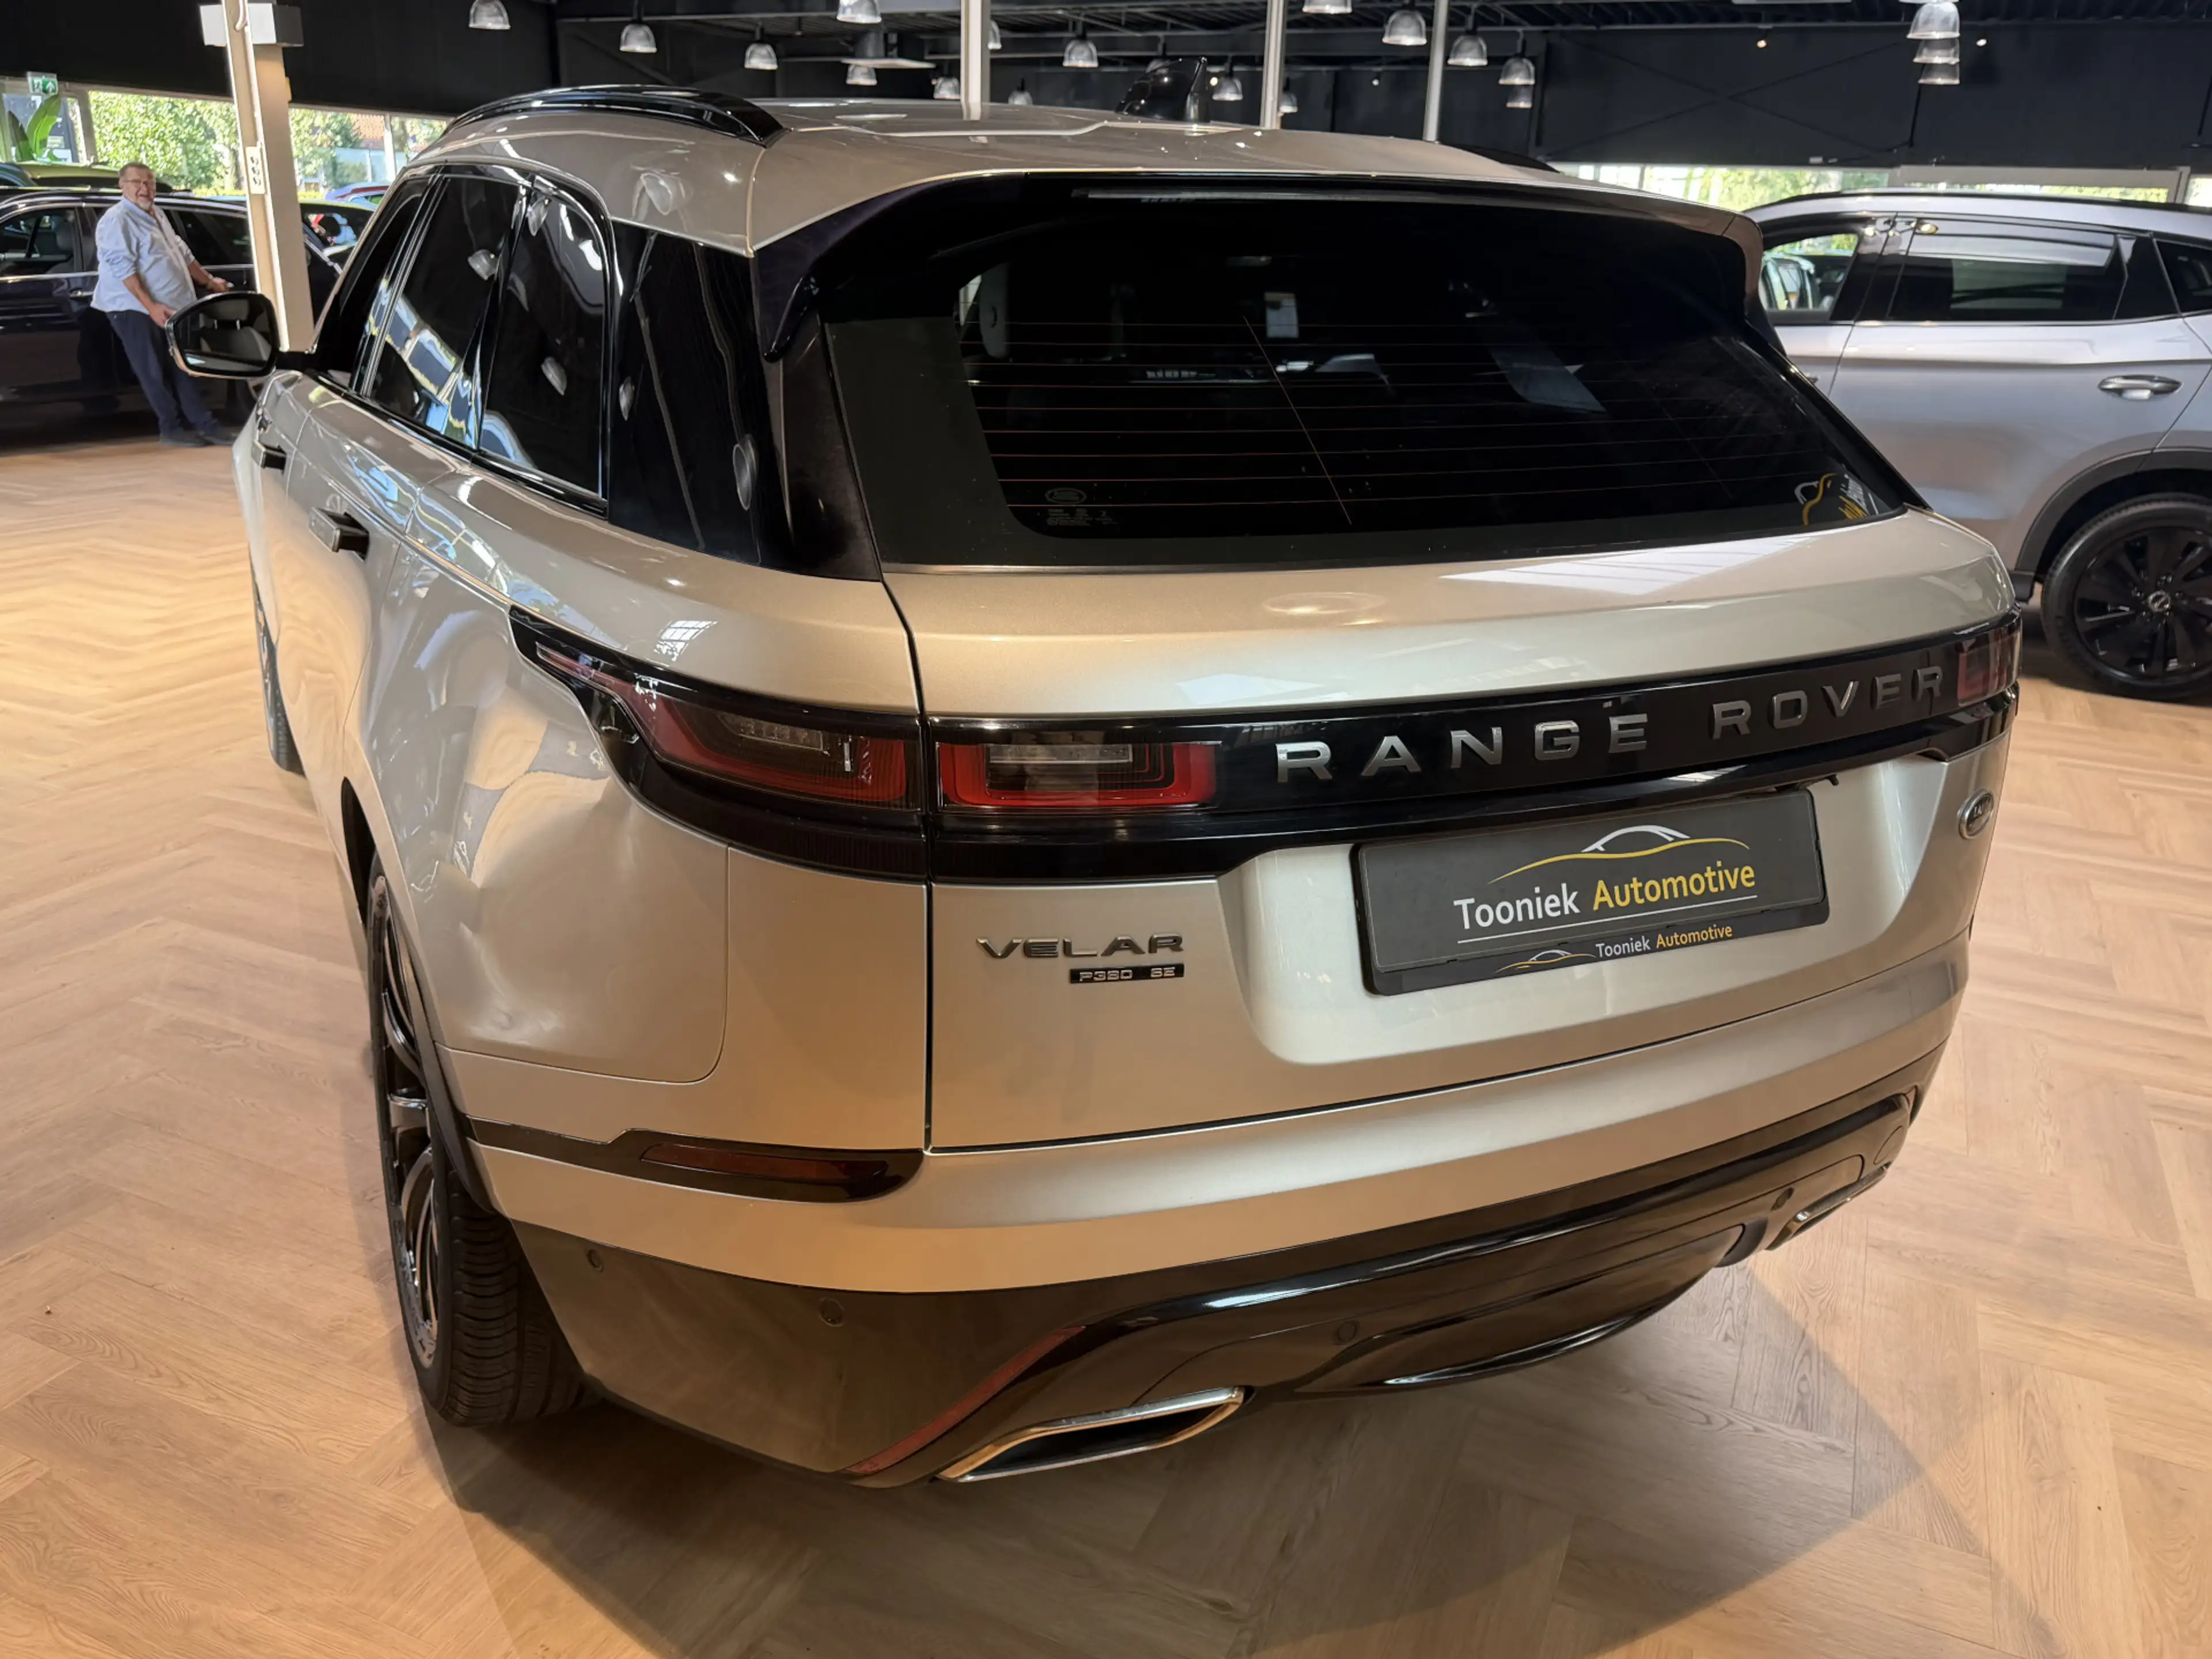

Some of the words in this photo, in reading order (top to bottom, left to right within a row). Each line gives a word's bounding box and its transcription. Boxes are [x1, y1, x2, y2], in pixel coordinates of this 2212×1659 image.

[1275, 713, 1649, 784] RANGE
[1711, 665, 1944, 740] ROVER
[1453, 882, 1581, 930] Tooniek
[1592, 861, 1756, 911] Automotive
[976, 931, 1184, 959] VELAR
[1595, 935, 1651, 959] Tooniek
[1656, 924, 1733, 949] Automotive
[1079, 969, 1133, 982] P380
